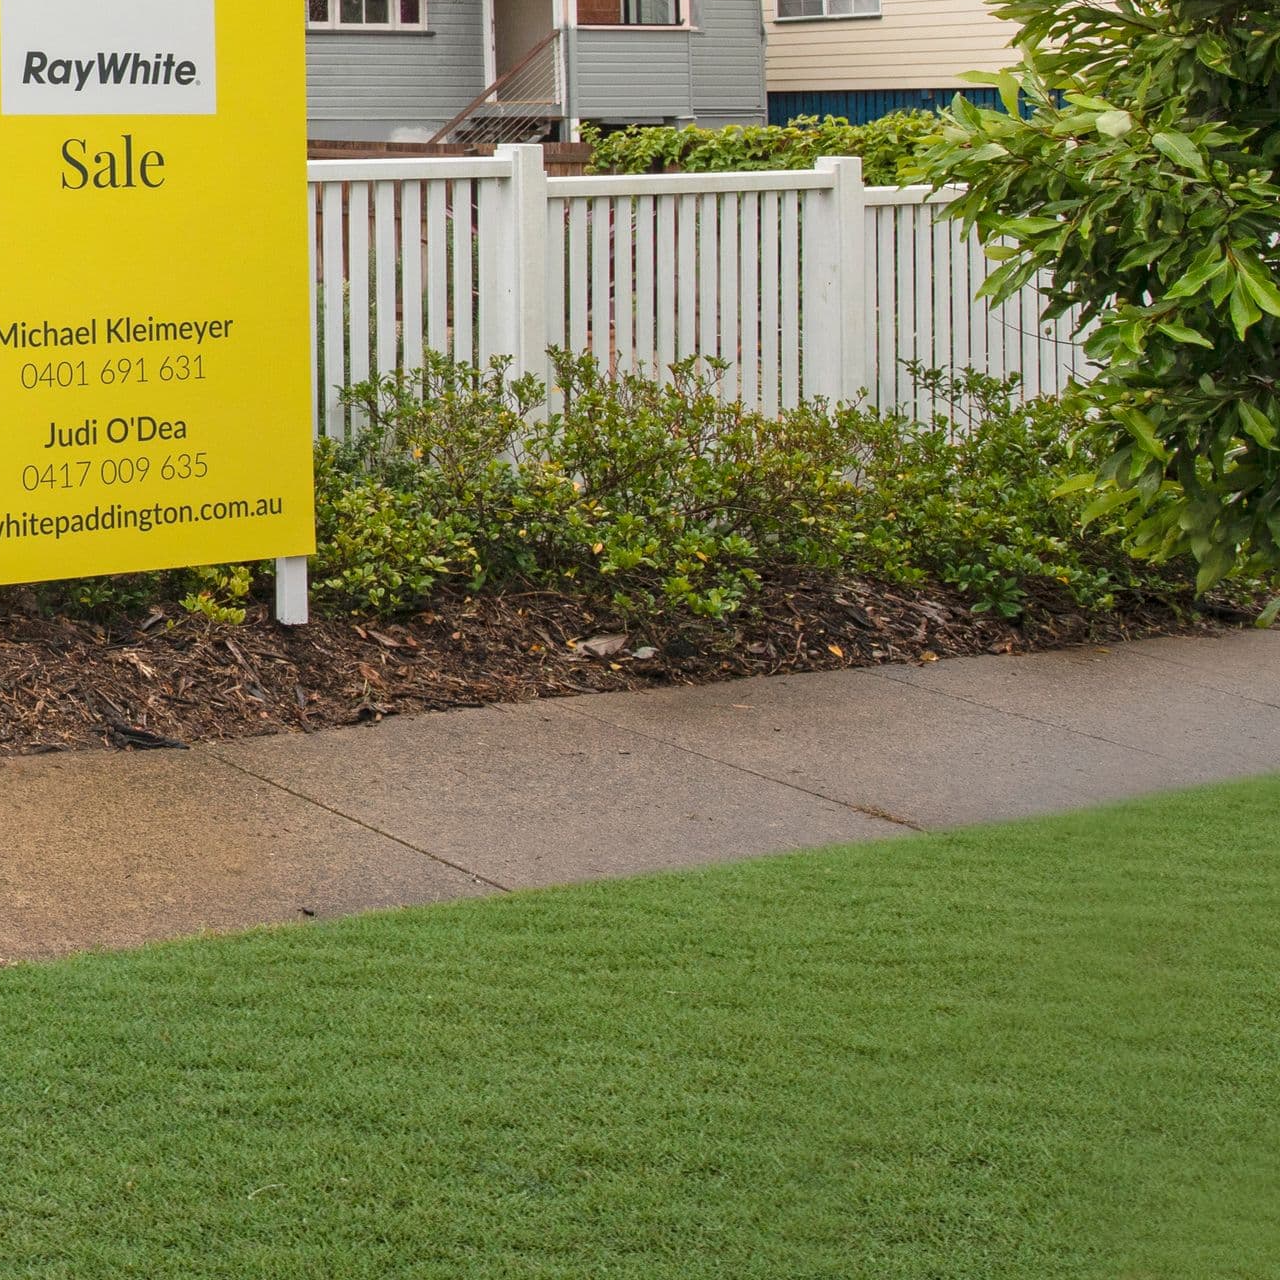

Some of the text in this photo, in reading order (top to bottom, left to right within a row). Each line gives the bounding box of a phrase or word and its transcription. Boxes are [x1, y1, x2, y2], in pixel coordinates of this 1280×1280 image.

[61, 134, 165, 190] Sale
[106, 316, 234, 346] Kleimeyer
[20, 354, 206, 390] 0401 691 631
[44, 415, 187, 449] Judi O'Dea
[21, 452, 208, 491] 0417 009 635
